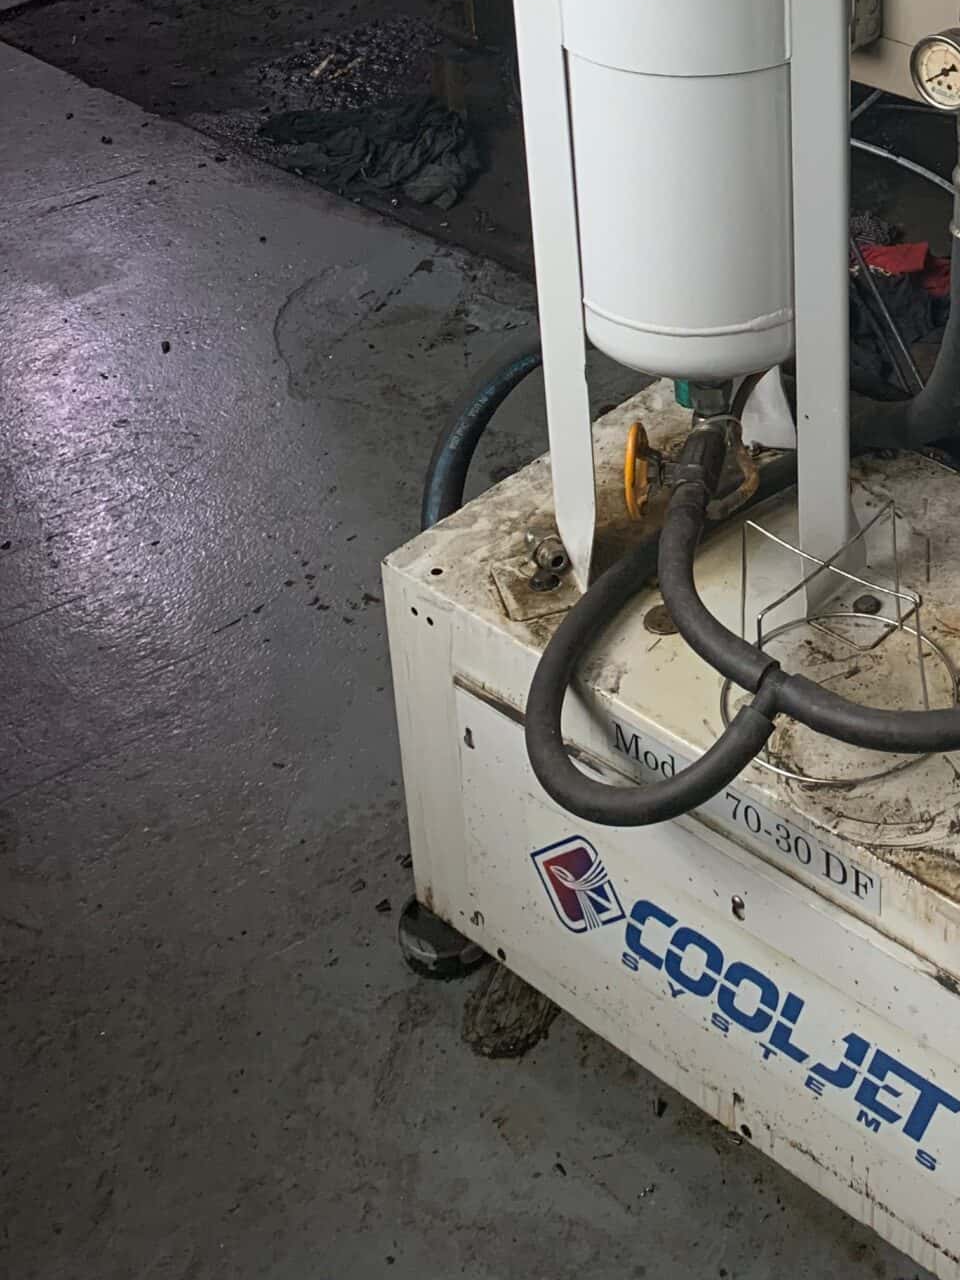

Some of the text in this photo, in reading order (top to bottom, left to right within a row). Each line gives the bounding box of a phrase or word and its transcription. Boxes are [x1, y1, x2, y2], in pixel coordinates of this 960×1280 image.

[614, 723, 874, 901] Mod 70-30 DF
[621, 951, 938, 1172] SYSTEMS
